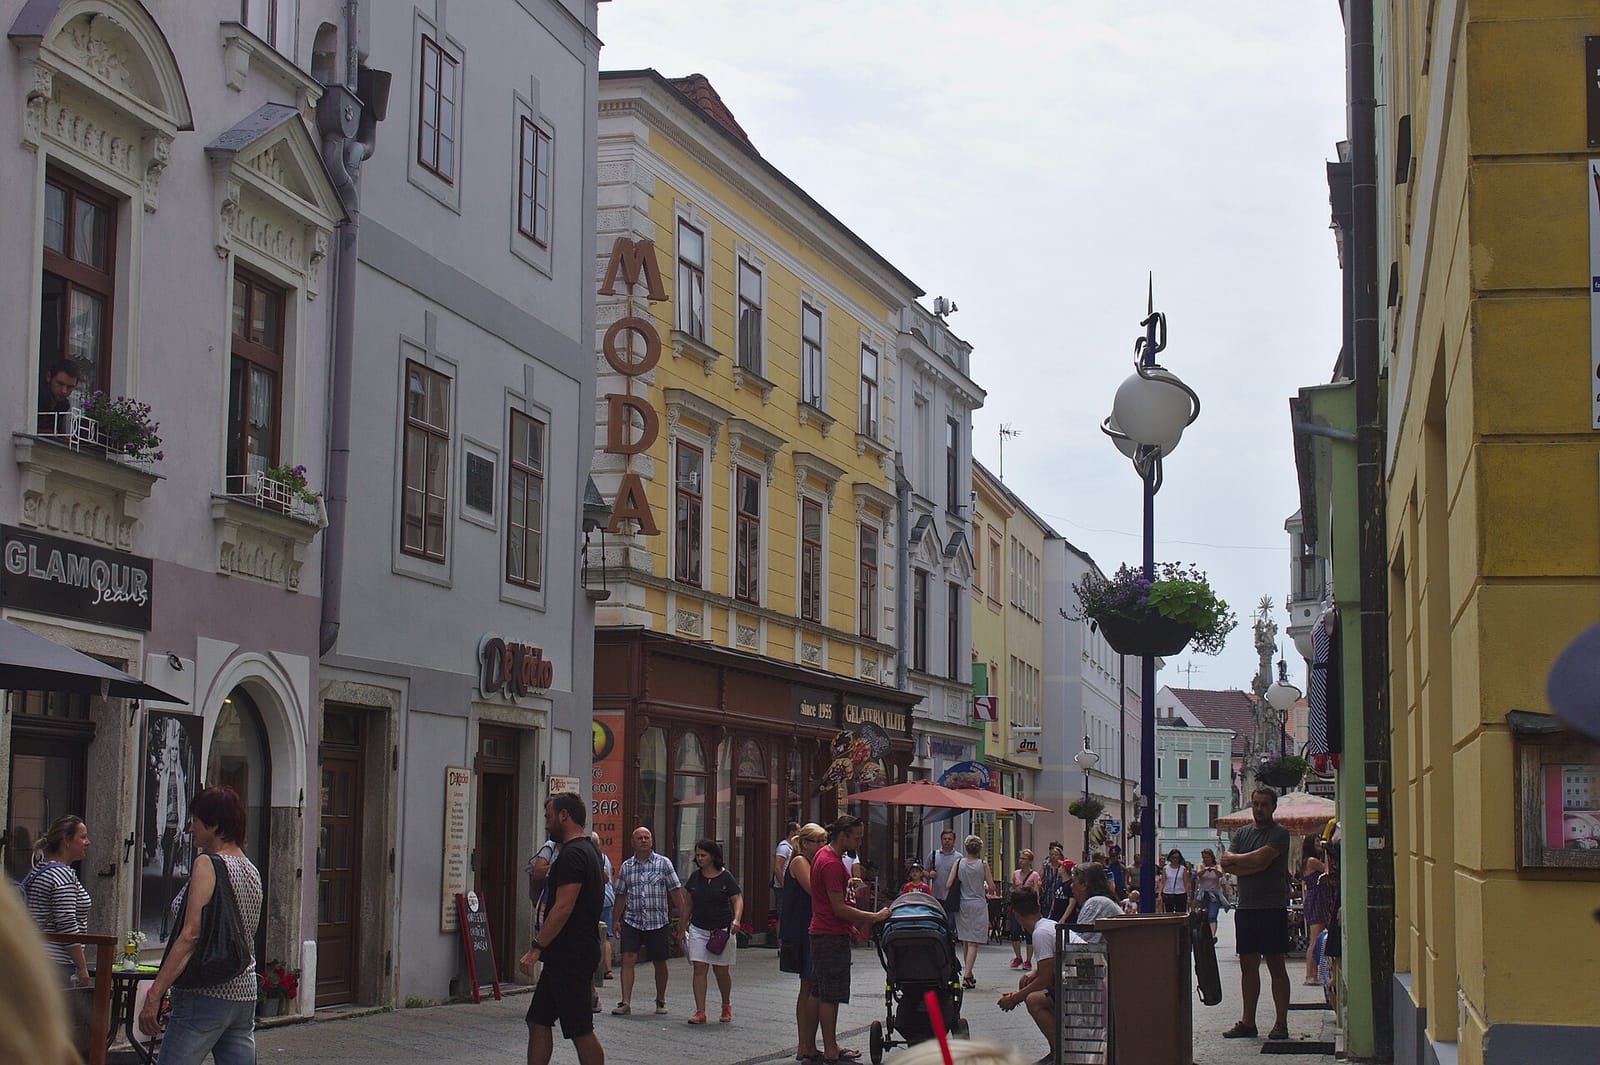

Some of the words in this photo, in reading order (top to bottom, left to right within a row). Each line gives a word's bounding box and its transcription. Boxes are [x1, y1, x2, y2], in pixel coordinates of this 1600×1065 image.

[597, 237, 669, 536] MODA
[4, 539, 148, 600] GLAMOUR
[92, 579, 148, 606] Jeans
[818, 703, 832, 720] 1955
[845, 704, 885, 728] GELATERIA
[886, 711, 906, 732] ELITE
[1020, 738, 1036, 749] dm
[592, 799, 620, 816] BAR
